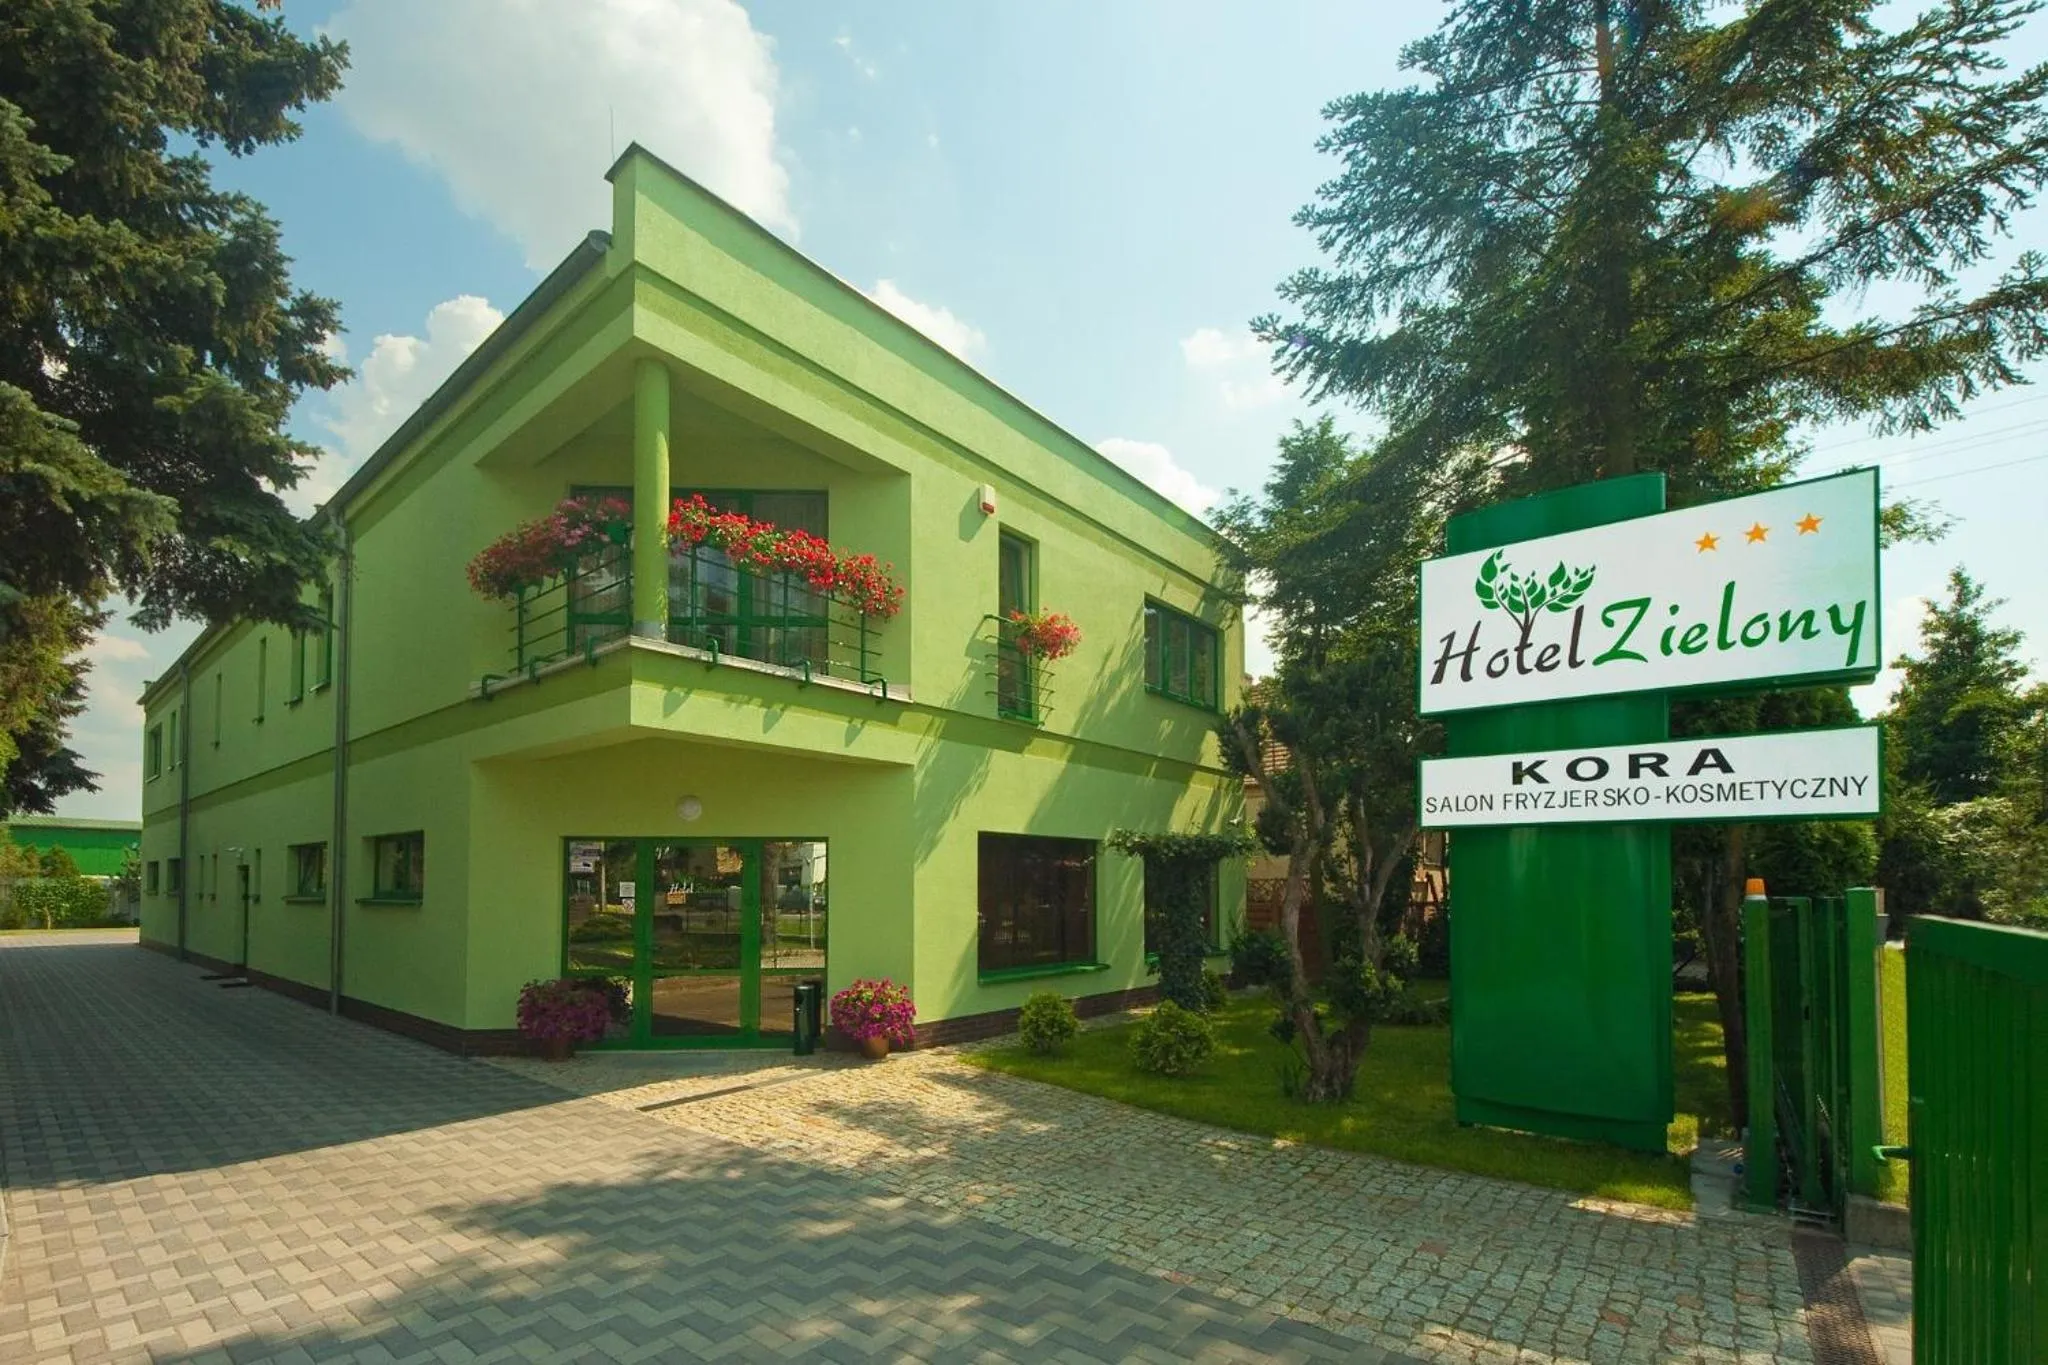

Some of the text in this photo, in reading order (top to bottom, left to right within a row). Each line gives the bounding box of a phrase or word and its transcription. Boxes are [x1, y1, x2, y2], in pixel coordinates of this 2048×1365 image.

[1430, 580, 1867, 685] Hotel Zielony
[1511, 748, 1736, 785] KORA
[1425, 796, 1494, 813] SALON
